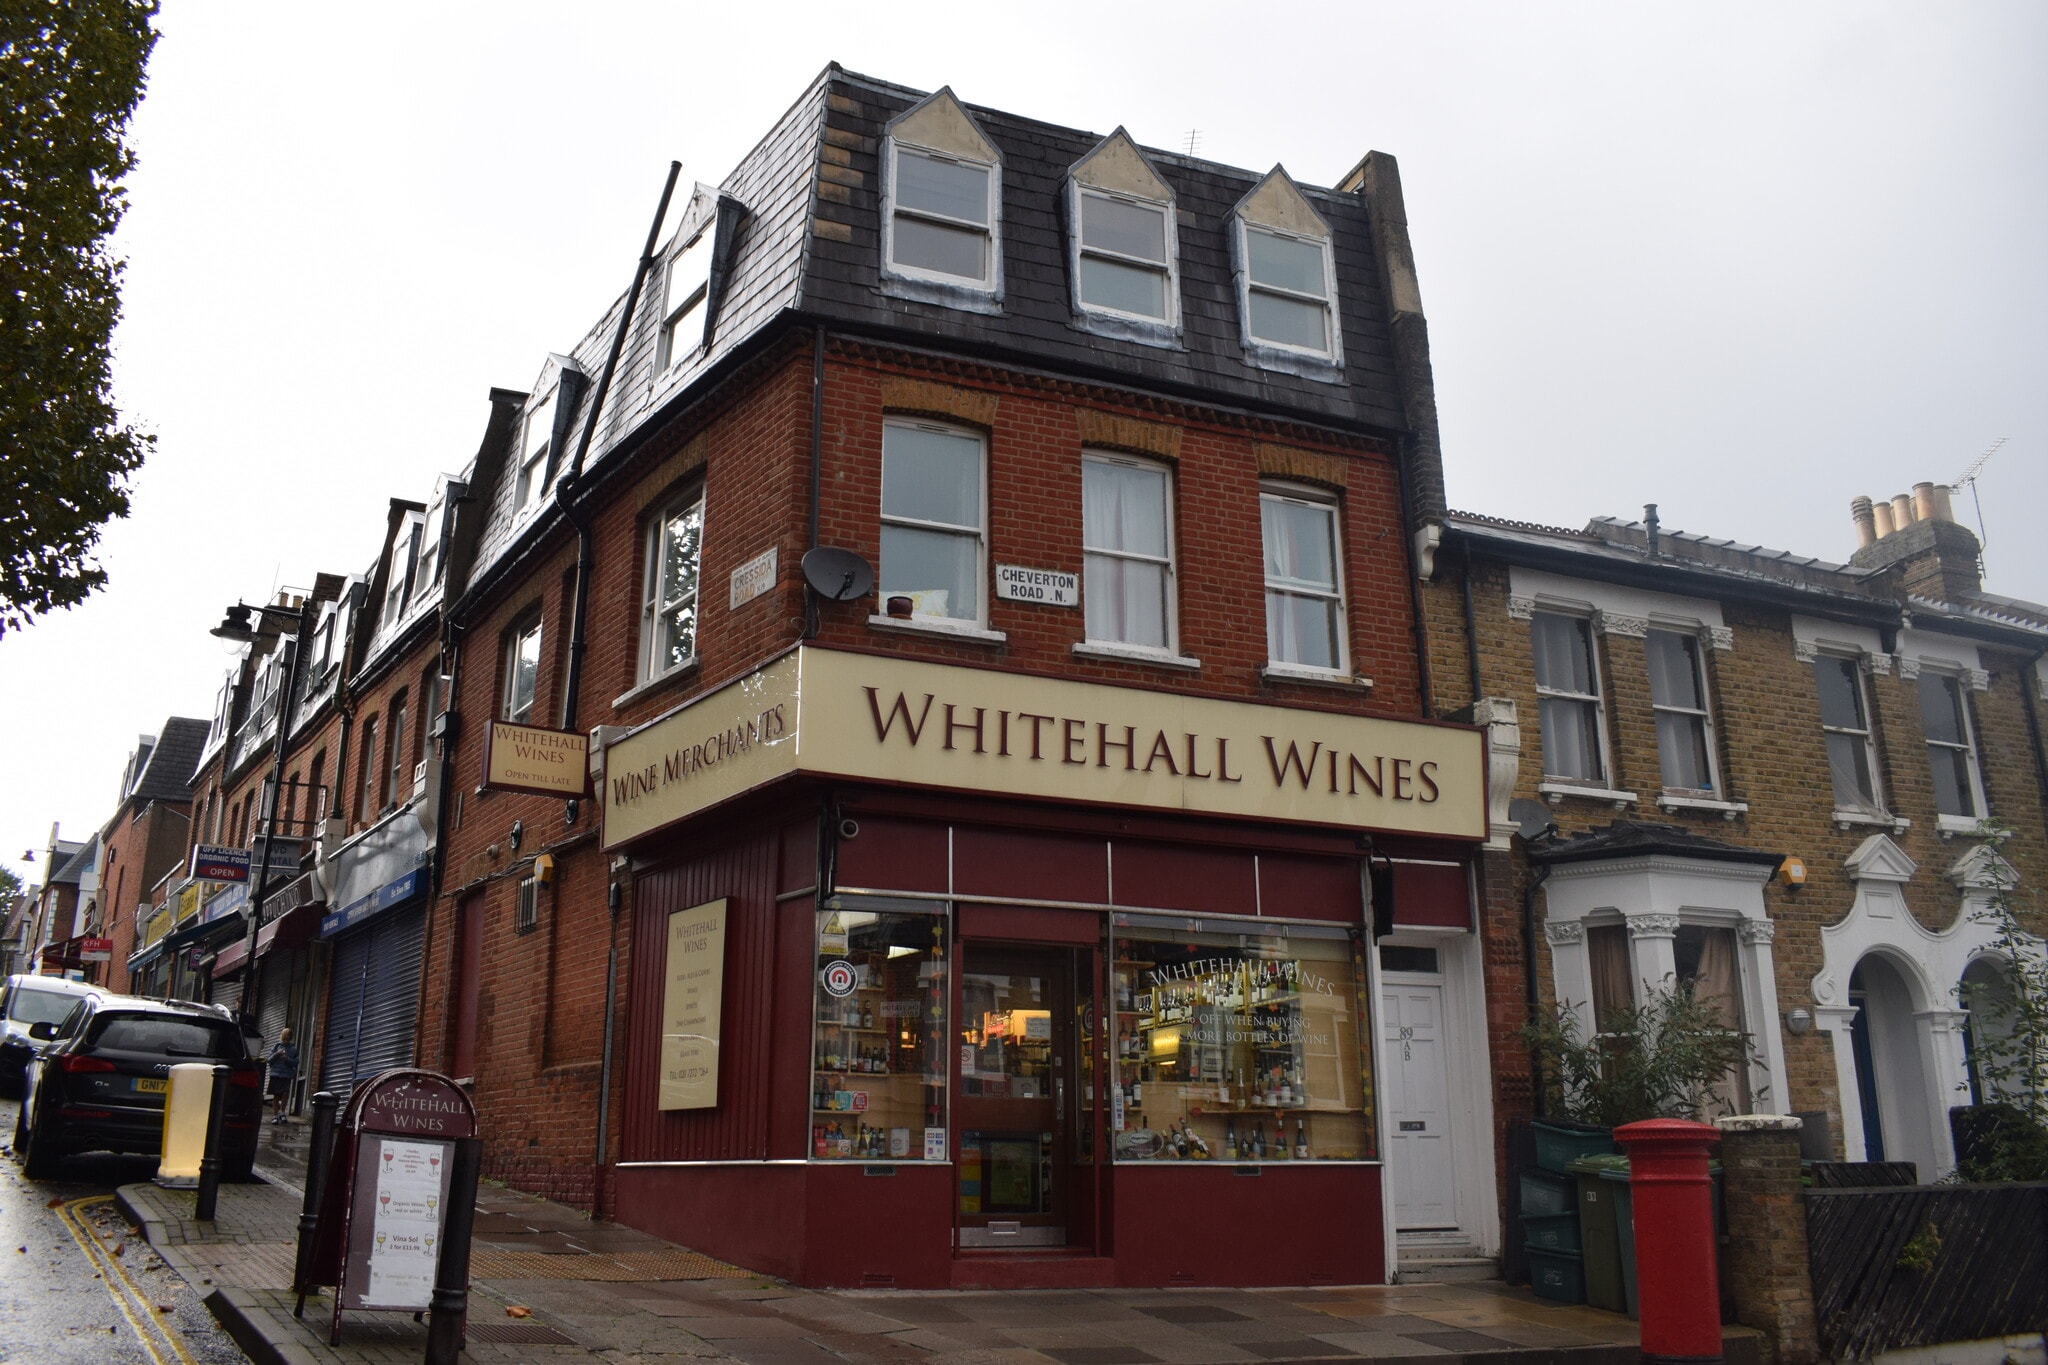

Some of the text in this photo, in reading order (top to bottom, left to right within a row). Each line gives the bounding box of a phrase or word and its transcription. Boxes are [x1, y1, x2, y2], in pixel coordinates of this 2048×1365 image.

[734, 558, 772, 589] CRESSIDA
[1002, 569, 1074, 589] CHEVERTON
[734, 583, 756, 606] ROAD
[1011, 584, 1044, 599] ROAD
[495, 726, 585, 751] WHITEHALL
[862, 686, 1440, 803] WHITEHALL WINES
[515, 744, 565, 764] WINES
[612, 703, 784, 807] WINE MERCHANTS
[505, 769, 571, 785] OPEN TILL LATE
[218, 848, 247, 857] LICENCE
[270, 843, 287, 854] VD
[199, 853, 249, 865] ORGANIC FOOD
[258, 856, 293, 867] RNTAL
[210, 867, 235, 877] OPEN
[676, 918, 718, 939] WHITEHALL
[83, 940, 101, 948] KFH
[684, 937, 708, 954] WINES
[1150, 957, 1335, 997] WHITEHALL WINES
[1200, 1013, 1221, 1025] OFF
[1225, 1014, 1265, 1027] WHEN
[1267, 1016, 1311, 1028] BUYING
[1186, 1030, 1221, 1041] MORE
[1226, 1032, 1275, 1043] BOTTLES
[1278, 1034, 1293, 1044] OF
[1294, 1033, 1329, 1045] WINE
[1400, 1026, 1413, 1040] 89
[1404, 1040, 1411, 1051] A
[1404, 1050, 1411, 1061] B
[375, 1092, 466, 1114] WHITEHALL
[393, 1113, 444, 1131] WINES
[409, 1235, 418, 1243] Sol
